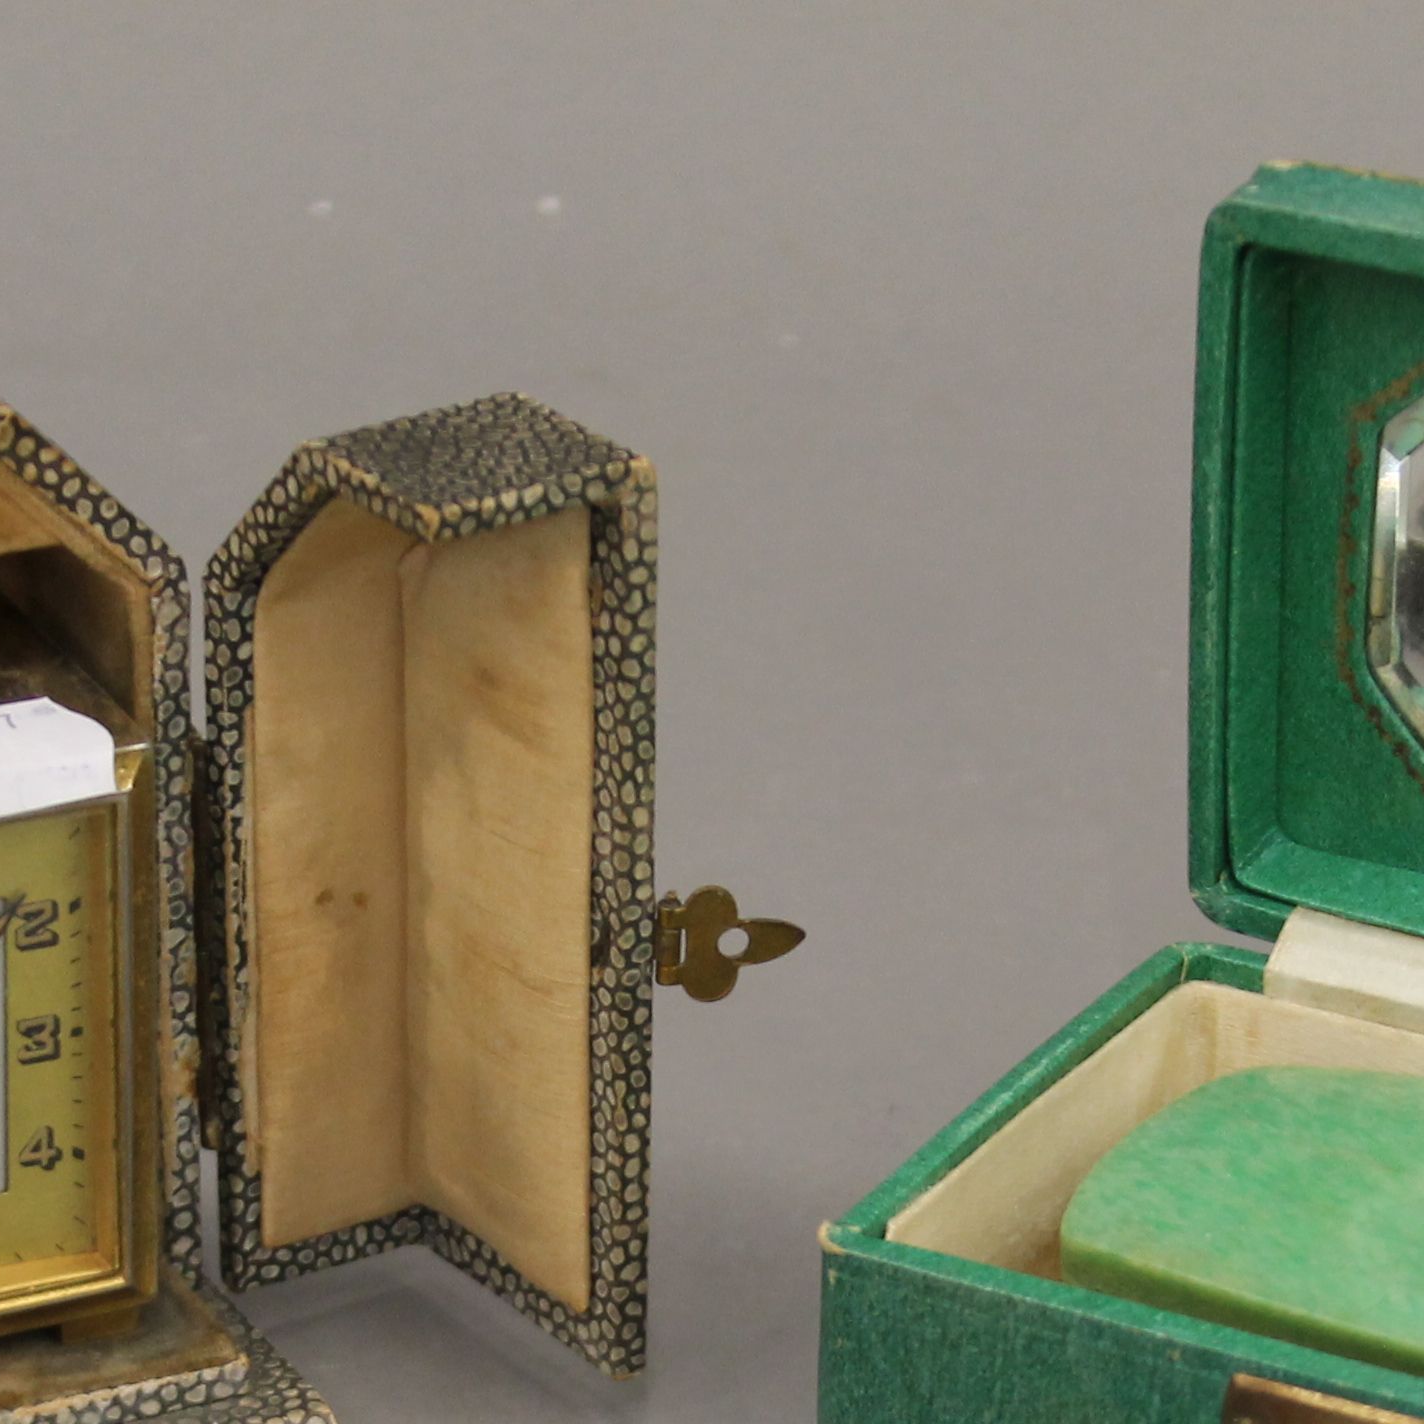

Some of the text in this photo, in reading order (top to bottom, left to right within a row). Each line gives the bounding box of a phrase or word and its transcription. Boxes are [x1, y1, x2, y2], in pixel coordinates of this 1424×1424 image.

[14, 899, 59, 952] 2
[16, 1013, 61, 1065] 3
[18, 1125, 63, 1171] 4
